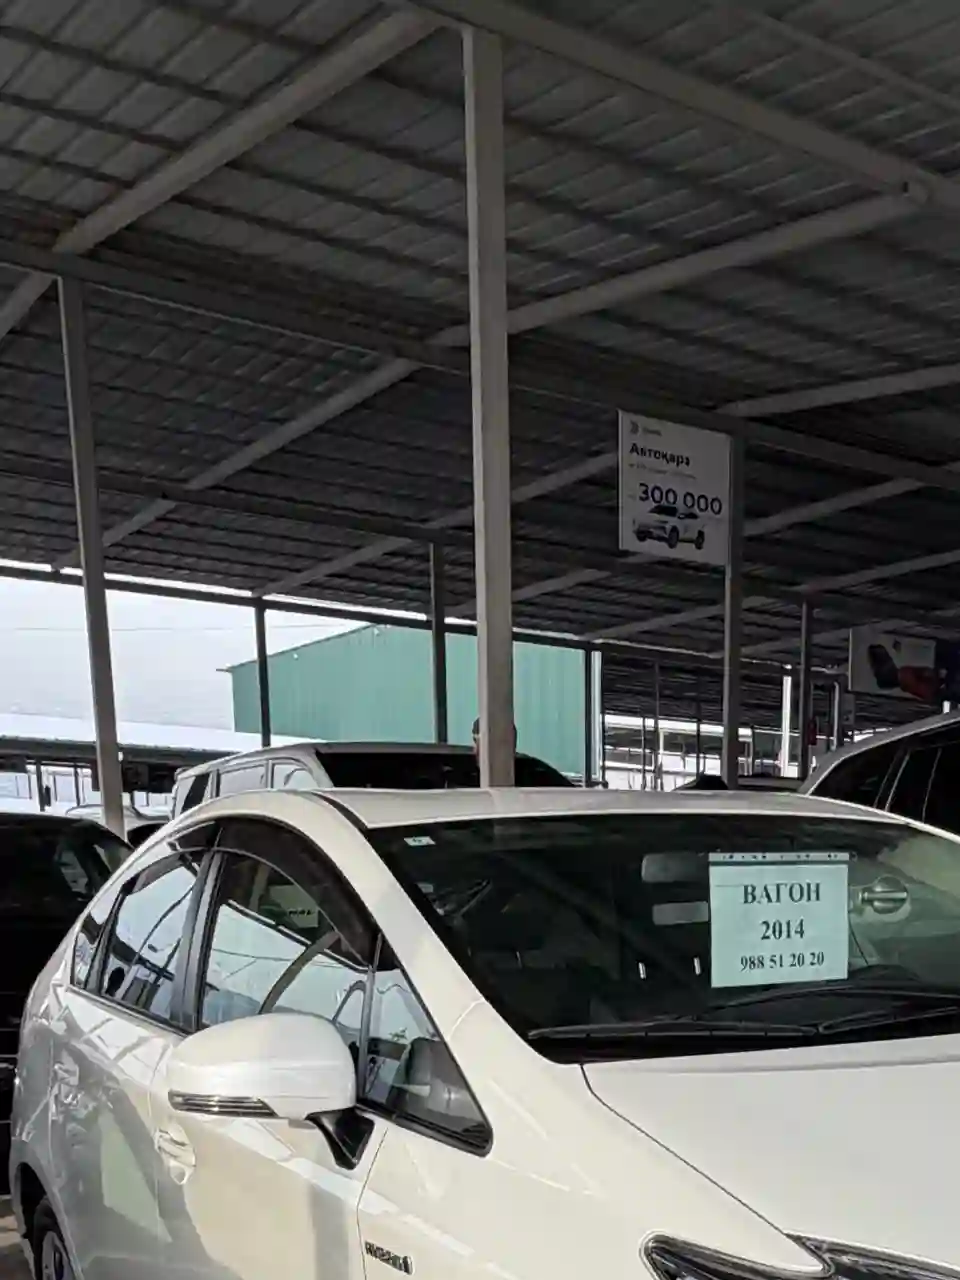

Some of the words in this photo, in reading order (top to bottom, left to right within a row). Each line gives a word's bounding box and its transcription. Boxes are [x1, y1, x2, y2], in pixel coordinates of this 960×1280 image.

[639, 482, 678, 506] 300
[683, 491, 722, 515] 000
[742, 881, 821, 904] ВАГОН
[760, 918, 805, 941] 2014
[740, 955, 765, 972] 988
[769, 954, 784, 969] 51
[789, 952, 805, 968] 20
[809, 951, 825, 967] 20
